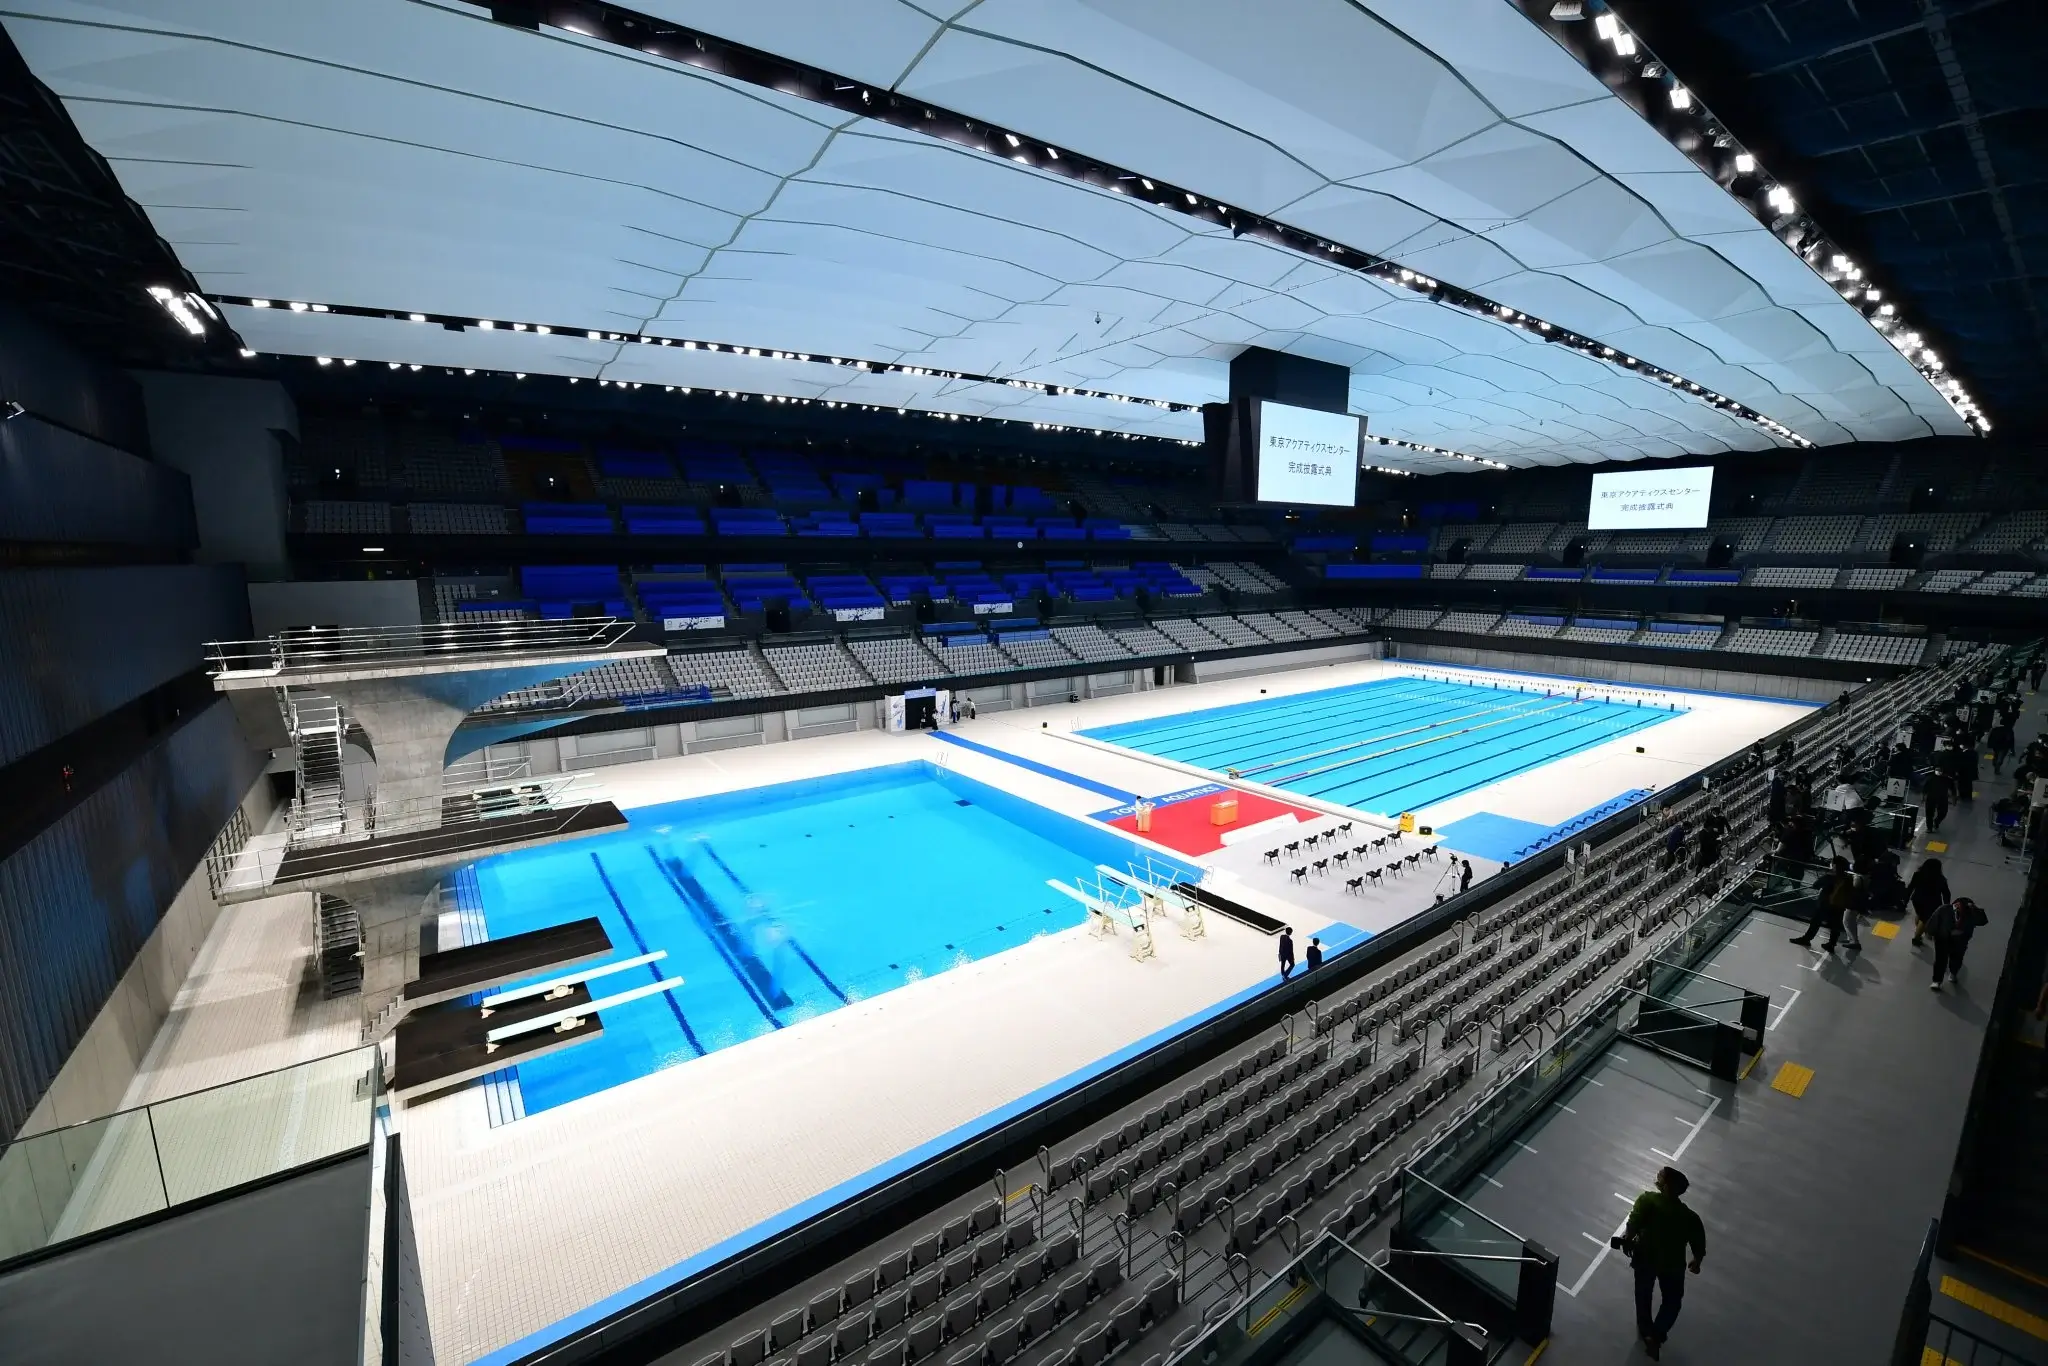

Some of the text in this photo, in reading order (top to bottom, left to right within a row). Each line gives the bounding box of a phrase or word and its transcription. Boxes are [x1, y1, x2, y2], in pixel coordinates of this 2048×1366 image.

[1269, 436, 1350, 455] 東京アクアティクスセンター
[1288, 461, 1332, 476] 完成披露式典
[1601, 487, 1700, 499] 東京アクアティクスセンター
